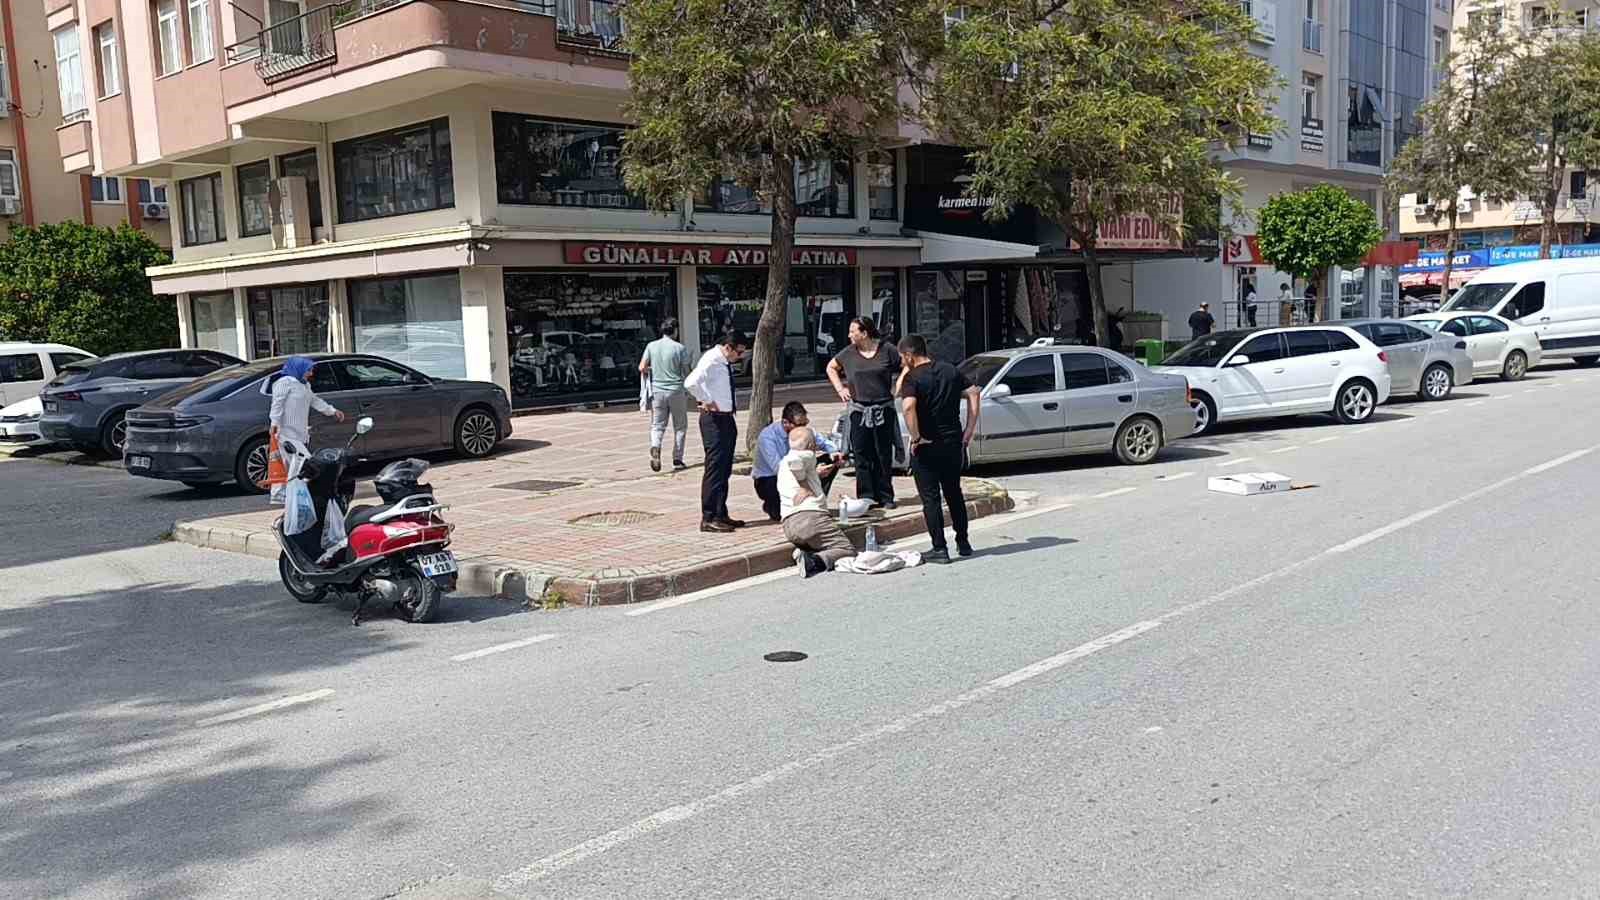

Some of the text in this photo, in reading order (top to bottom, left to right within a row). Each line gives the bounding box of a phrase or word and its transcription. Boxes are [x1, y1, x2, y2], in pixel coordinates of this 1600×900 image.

[583, 244, 849, 265] GÜNALLAR AYDLATMA
[1430, 255, 1471, 267] MAKET
